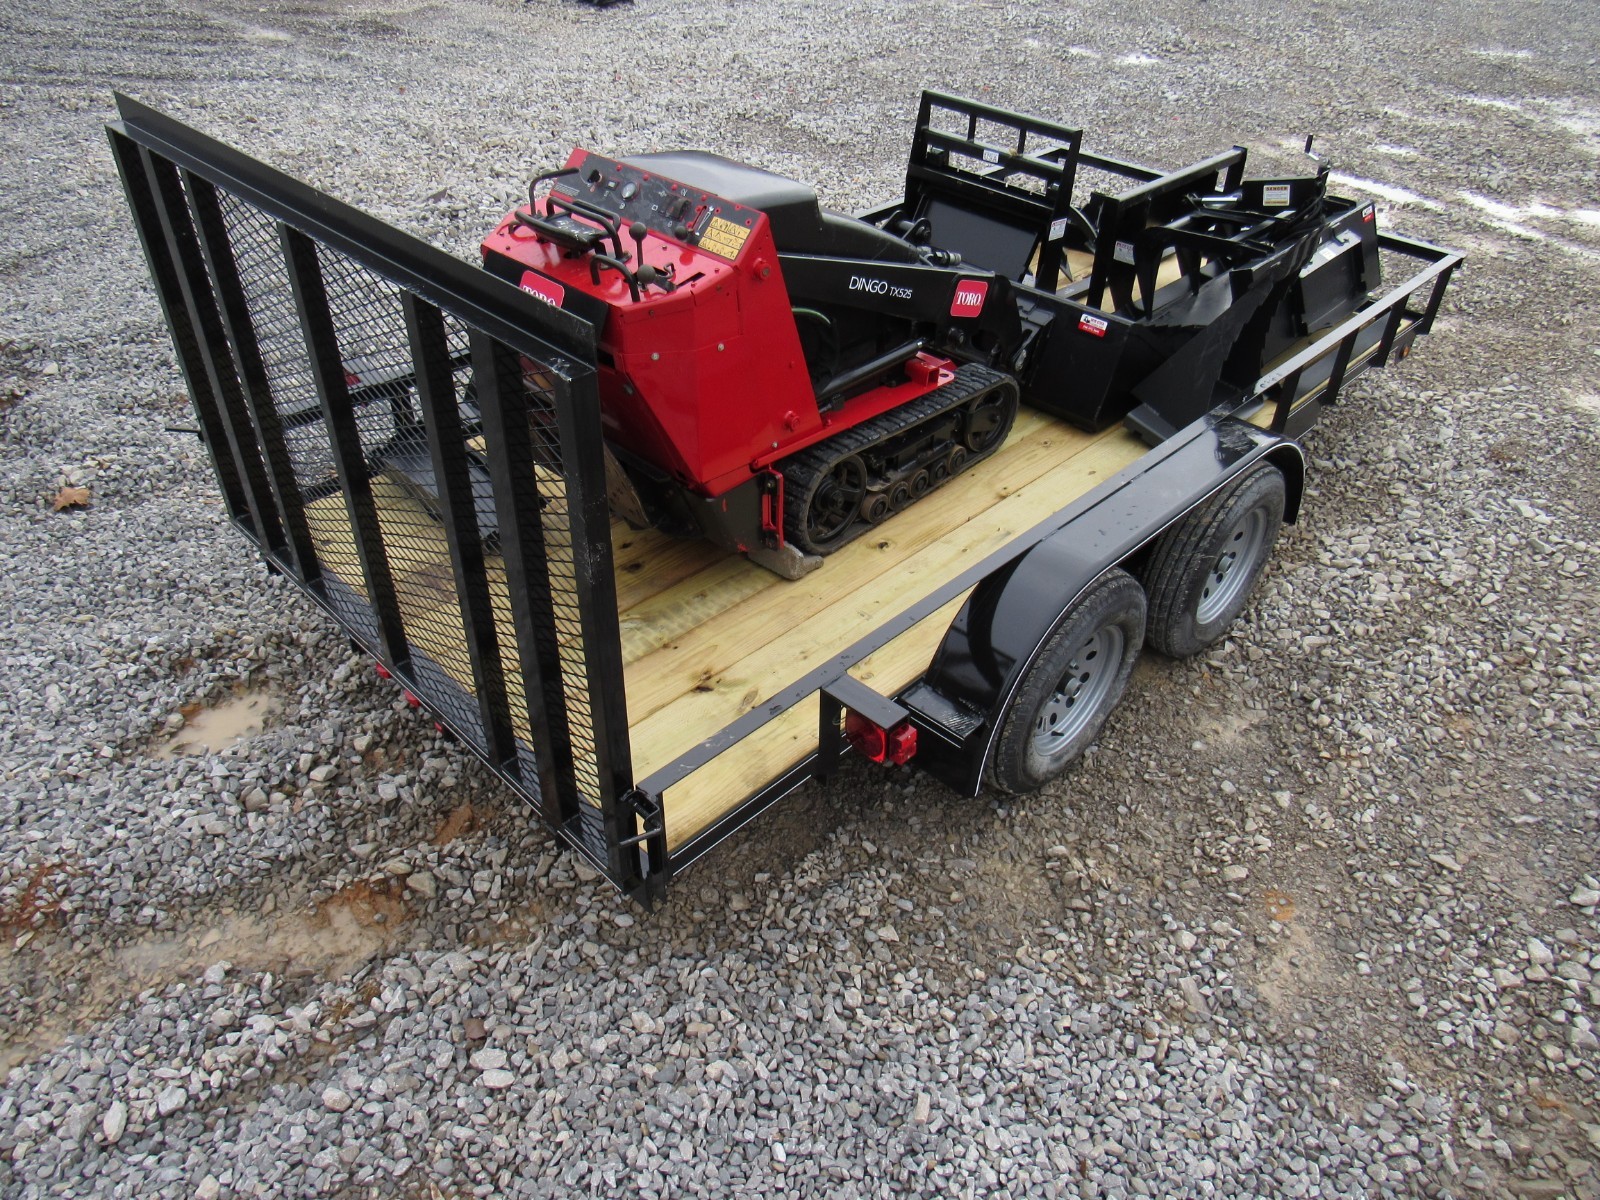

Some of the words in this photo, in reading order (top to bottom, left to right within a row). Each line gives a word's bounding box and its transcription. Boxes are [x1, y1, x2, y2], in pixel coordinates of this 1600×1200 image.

[848, 276, 888, 295] DINGO
[889, 286, 913, 300] TX525
[956, 291, 982, 306] TORO
